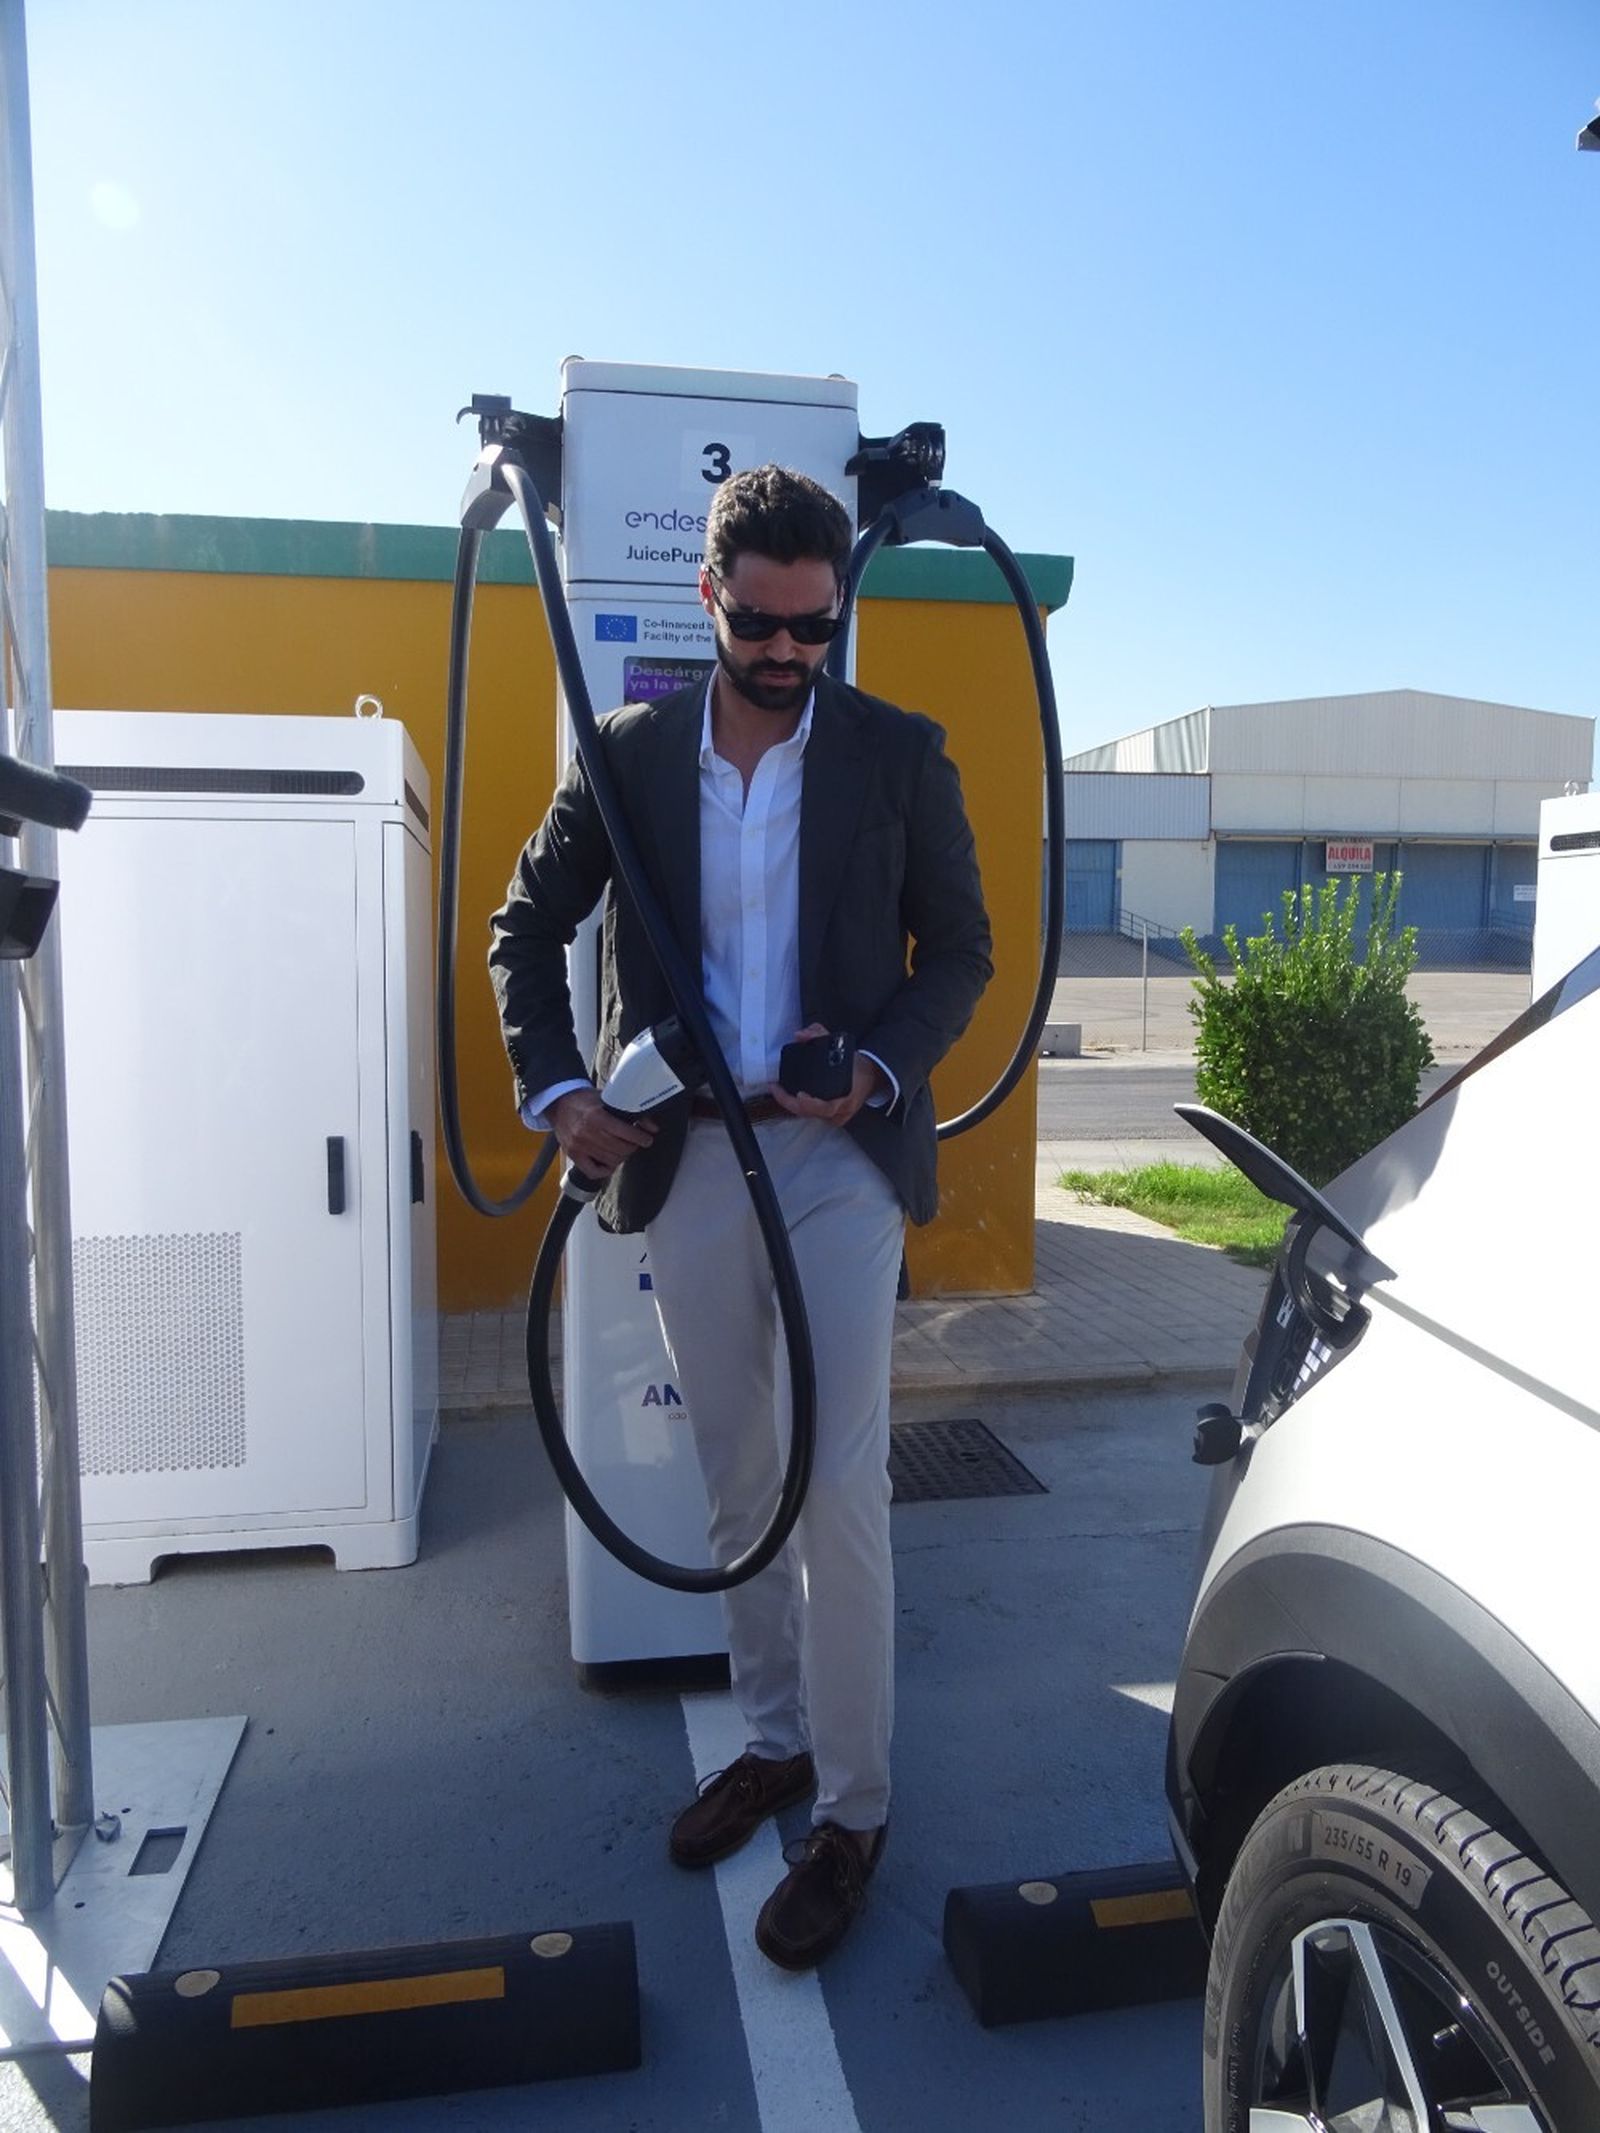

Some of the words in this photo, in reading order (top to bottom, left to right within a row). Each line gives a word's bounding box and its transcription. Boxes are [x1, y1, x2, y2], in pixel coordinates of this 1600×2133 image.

[702, 443, 731, 484] 3
[625, 509, 708, 533] endes
[643, 619, 705, 630] Co-financed
[707, 621, 714, 631] b
[644, 632, 681, 643] Facility
[683, 632, 693, 642] of
[631, 681, 648, 692] ya
[654, 679, 668, 691] la
[1328, 847, 1371, 861] ALQUILA
[641, 1384, 682, 1406] AN
[1324, 1826, 1375, 1861] 235/55
[1378, 1845, 1390, 1871] R
[1395, 1862, 1413, 1888] 19
[1486, 1961, 1556, 2065] OUTSIDE
